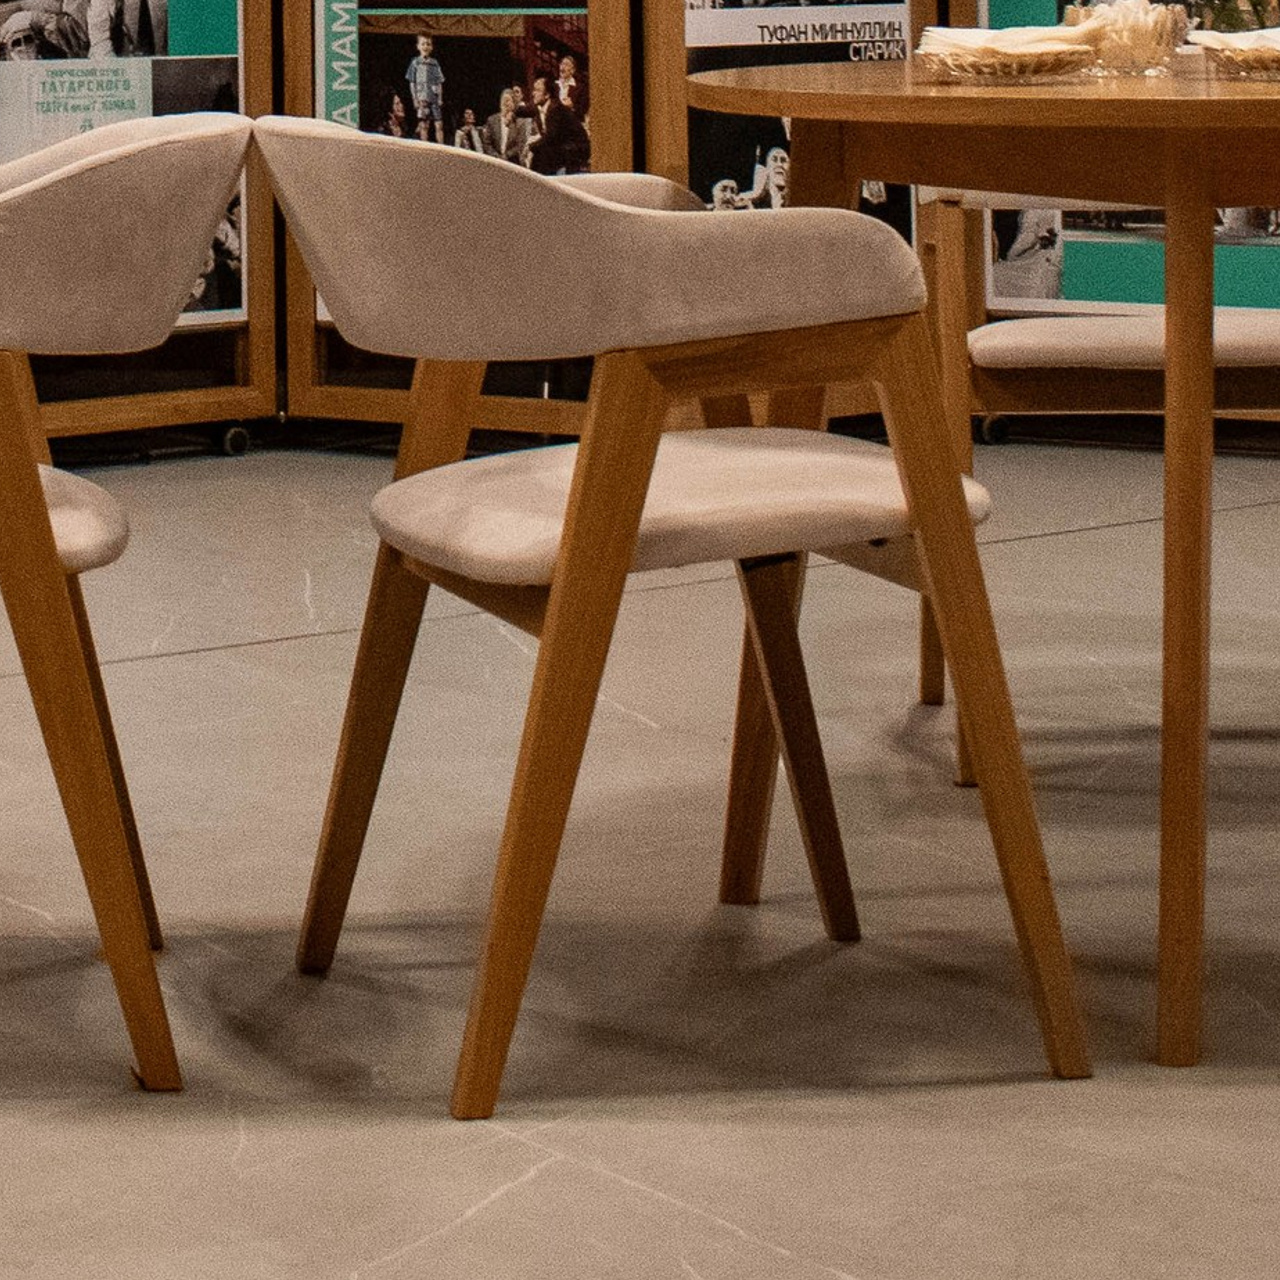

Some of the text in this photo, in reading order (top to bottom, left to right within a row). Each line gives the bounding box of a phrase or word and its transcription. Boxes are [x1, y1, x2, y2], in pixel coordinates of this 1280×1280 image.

[757, 21, 902, 43] ТУФАН МИННУЛЛИН
[849, 41, 904, 61] СТАРИК
